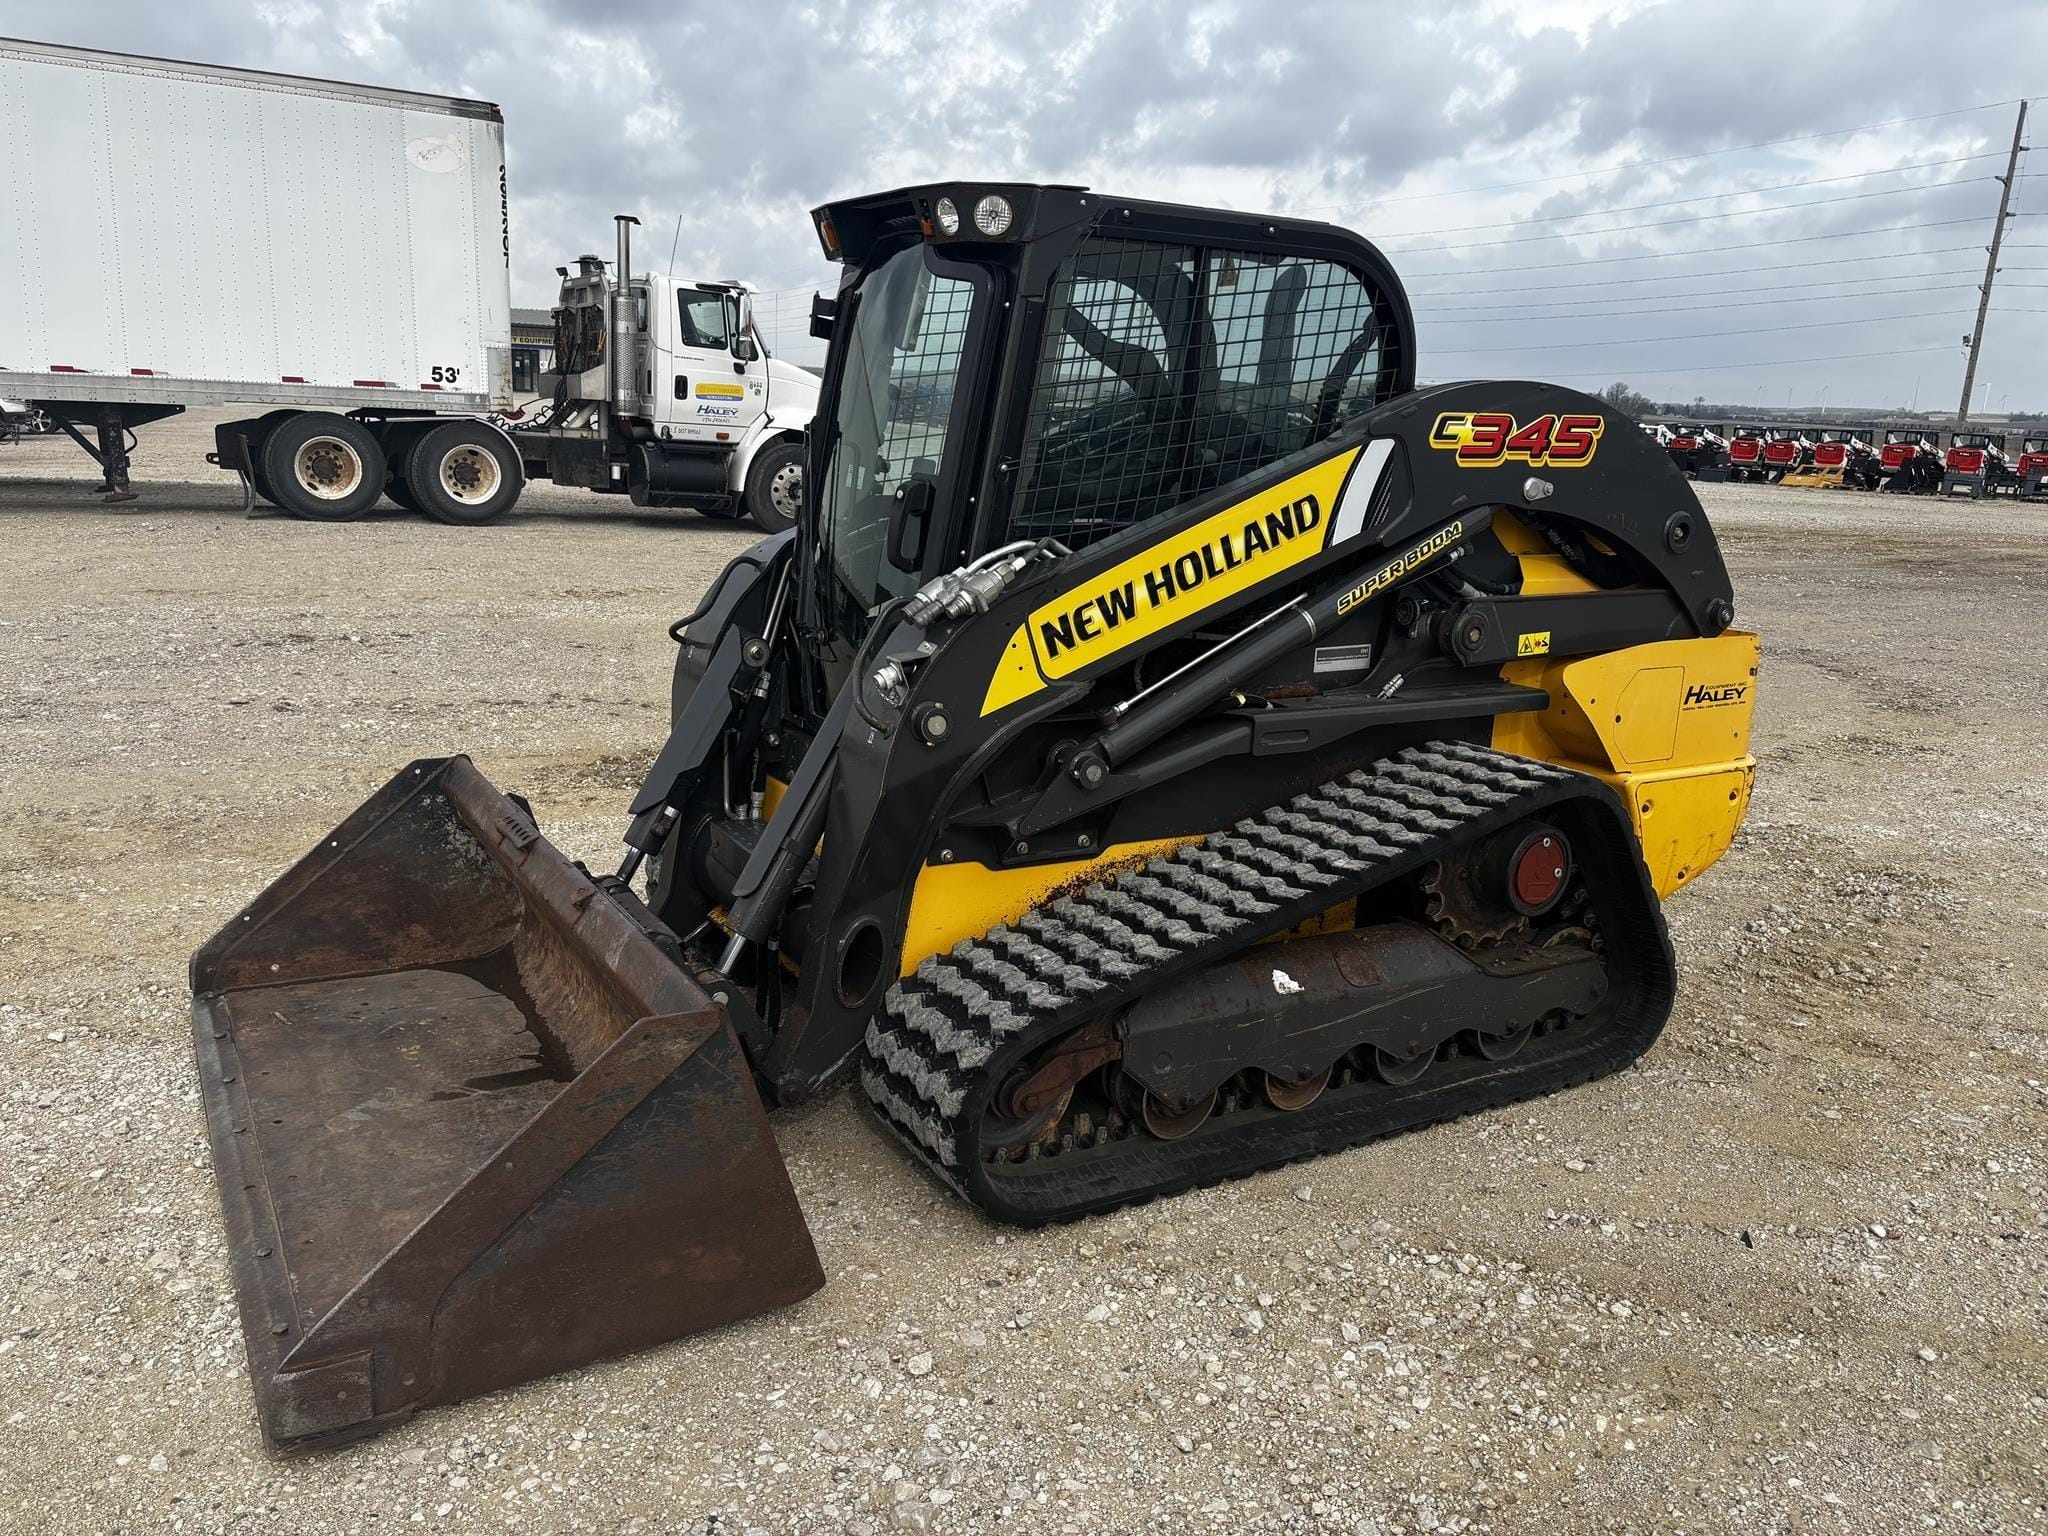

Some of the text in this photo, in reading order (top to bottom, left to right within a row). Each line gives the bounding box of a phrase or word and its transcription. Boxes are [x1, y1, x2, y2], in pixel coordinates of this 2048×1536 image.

[519, 337, 553, 345] EQUIPME
[431, 366, 460, 383] 53'
[697, 405, 738, 416] HALEY
[1337, 519, 1463, 615] SUPER BOOM
[1040, 494, 1321, 659] NEW HOLLAND
[1683, 684, 1747, 705] HALEY
[1705, 682, 1736, 690] EQUIPMENT
